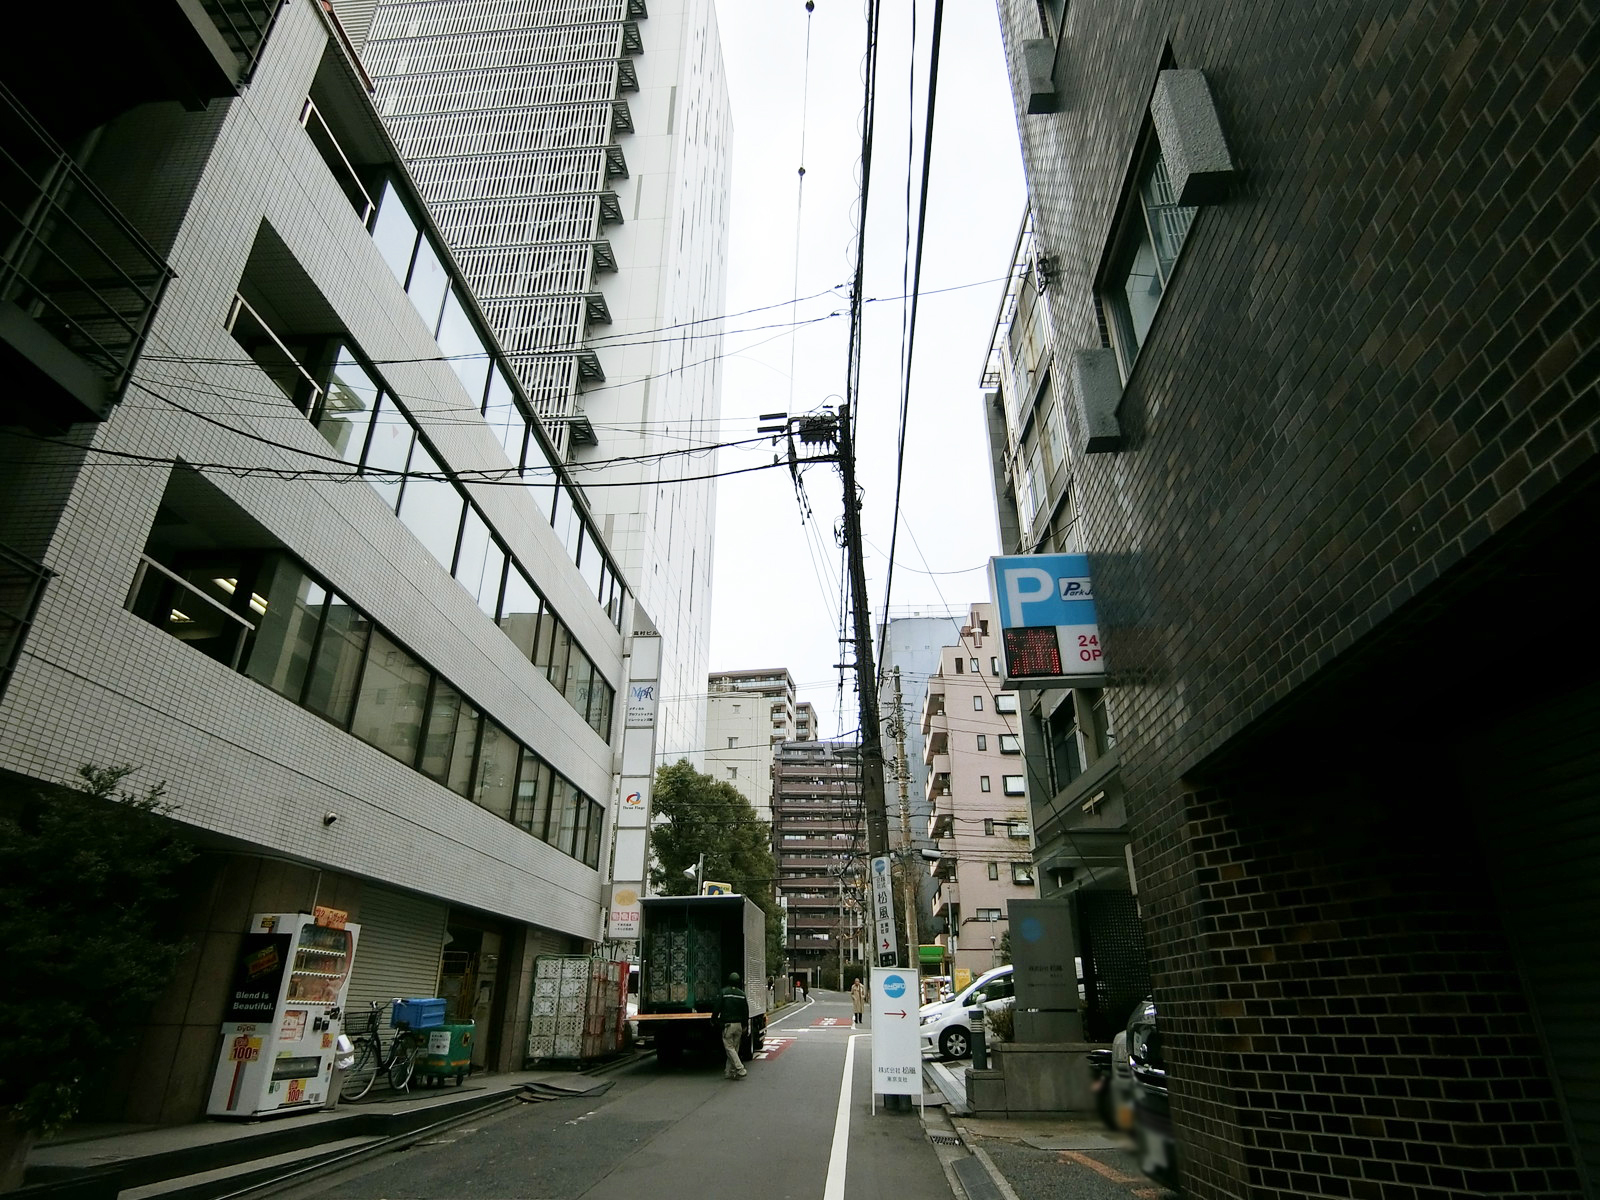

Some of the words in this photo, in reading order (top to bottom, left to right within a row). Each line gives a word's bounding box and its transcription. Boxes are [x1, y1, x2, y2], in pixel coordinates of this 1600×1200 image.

[1004, 567, 1054, 627] P
[1077, 635, 1099, 647] 24
[878, 891, 889, 919] 松風
[236, 991, 260, 1000] Blend
[261, 991, 270, 1000] is
[233, 1002, 274, 1011] Beautiful.
